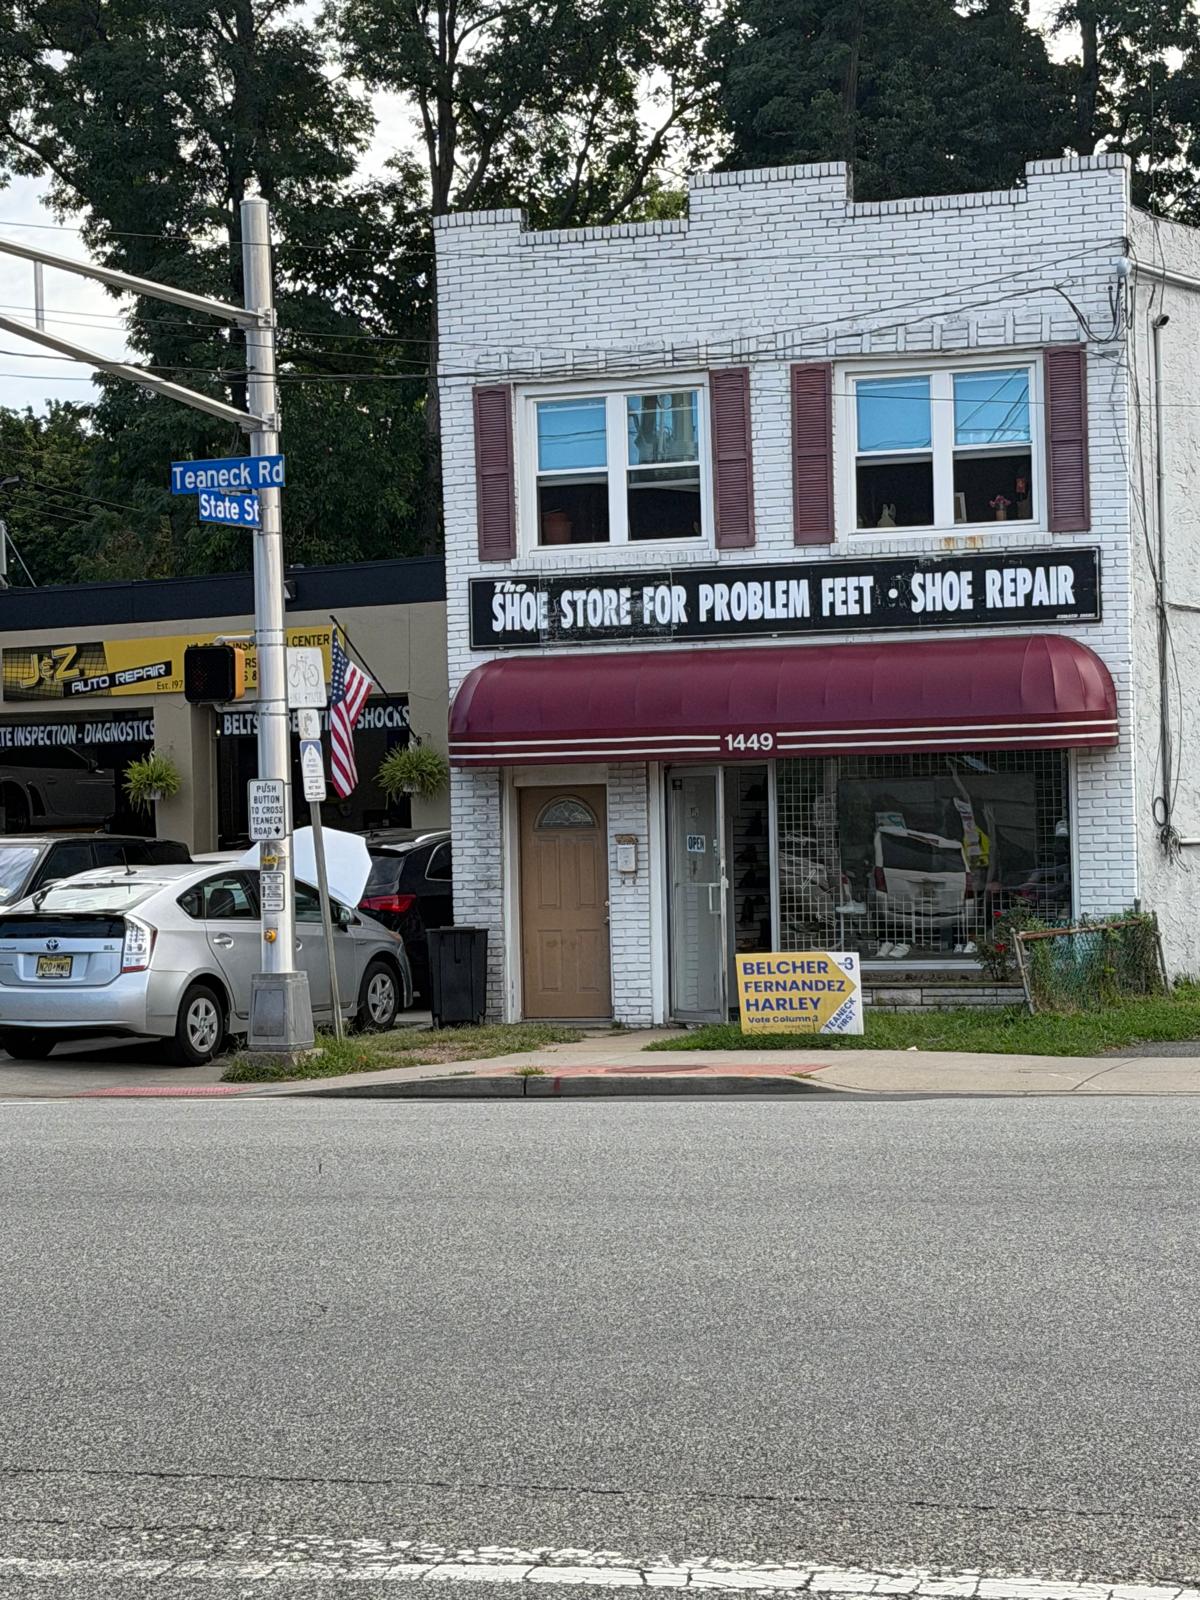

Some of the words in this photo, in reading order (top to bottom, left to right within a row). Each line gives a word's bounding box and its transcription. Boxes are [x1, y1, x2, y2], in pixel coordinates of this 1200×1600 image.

[172, 463, 252, 489] Teaneck
[259, 460, 283, 484] Rd
[201, 494, 239, 519] State
[244, 499, 259, 521] St
[494, 582, 526, 593] The
[492, 591, 548, 631] SHOE
[561, 587, 631, 628] STORE
[643, 585, 687, 624] FOR
[699, 579, 810, 622] PROBLEM
[821, 576, 873, 616] FEET
[911, 571, 973, 613] SHOE
[985, 566, 1075, 608] REPAIR
[292, 634, 330, 647] CENTER
[20, 645, 80, 688] J&Z
[72, 676, 109, 693] AUTO
[115, 664, 166, 684] REPAIR
[156, 681, 171, 690] Est.
[172, 680, 184, 689] 197
[224, 713, 258, 735] BELTS
[357, 705, 410, 728] SHOCKS
[14, 724, 77, 746] INSPECTION
[84, 720, 154, 743] DIAGNOSTICS
[725, 733, 773, 751] 1449
[256, 785, 277, 793] PUSH
[254, 795, 280, 804] BUTTON
[251, 807, 259, 815] TO
[262, 806, 283, 814] CROSS
[252, 816, 283, 825] TEANECK
[254, 827, 272, 835] ROAD
[688, 836, 704, 850] OPEN
[743, 961, 828, 975] BELCHER
[844, 957, 854, 970] 3
[744, 980, 846, 993] FERNANDEZ
[746, 997, 821, 1012] HARLEY
[748, 1016, 770, 1024] Vote
[772, 1015, 811, 1024] Column
[825, 997, 857, 1031] TEANECK
[837, 1010, 856, 1031] FIRST
